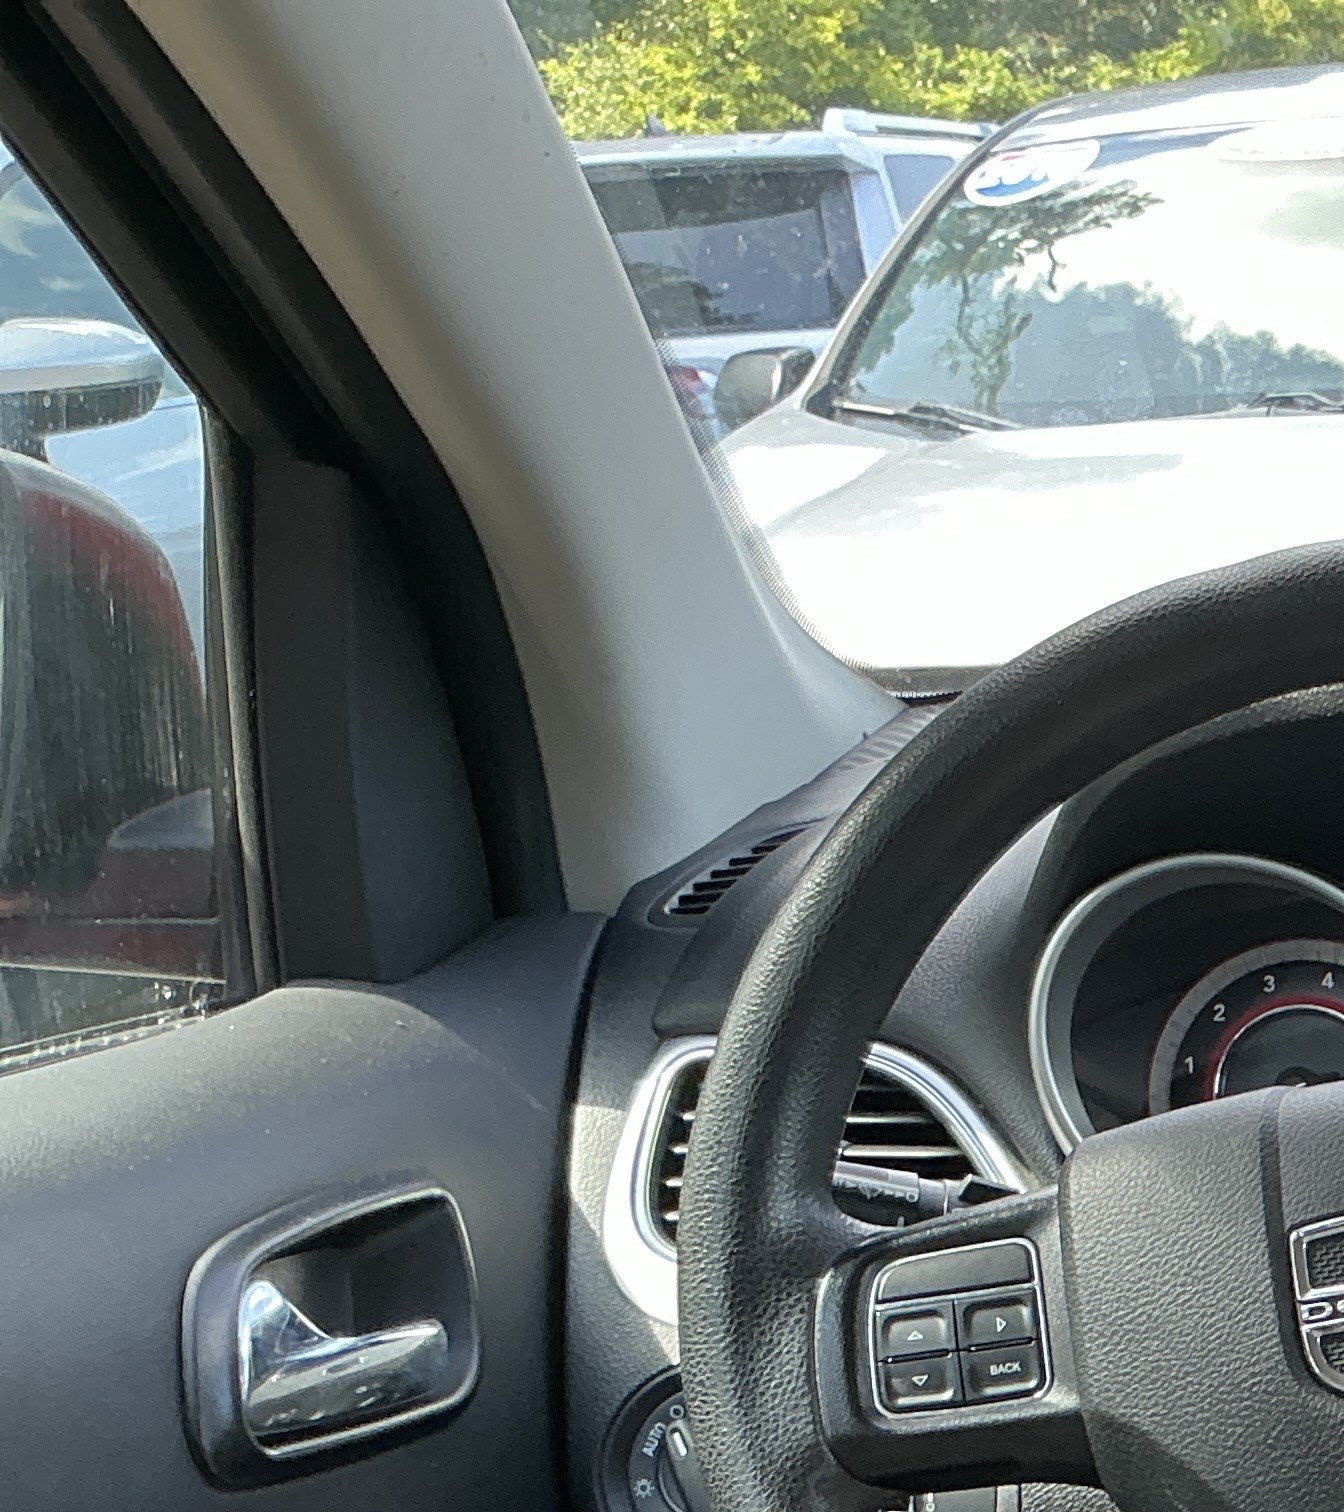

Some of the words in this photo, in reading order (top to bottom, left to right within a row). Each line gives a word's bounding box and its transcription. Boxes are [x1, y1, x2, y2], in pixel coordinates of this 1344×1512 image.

[1263, 975, 1276, 994] 3
[1320, 972, 1335, 989] 4
[1213, 1003, 1226, 1022] 2
[1184, 1056, 1195, 1074] 1
[989, 1361, 1022, 1376] BACK
[642, 1421, 666, 1457] AUTO
